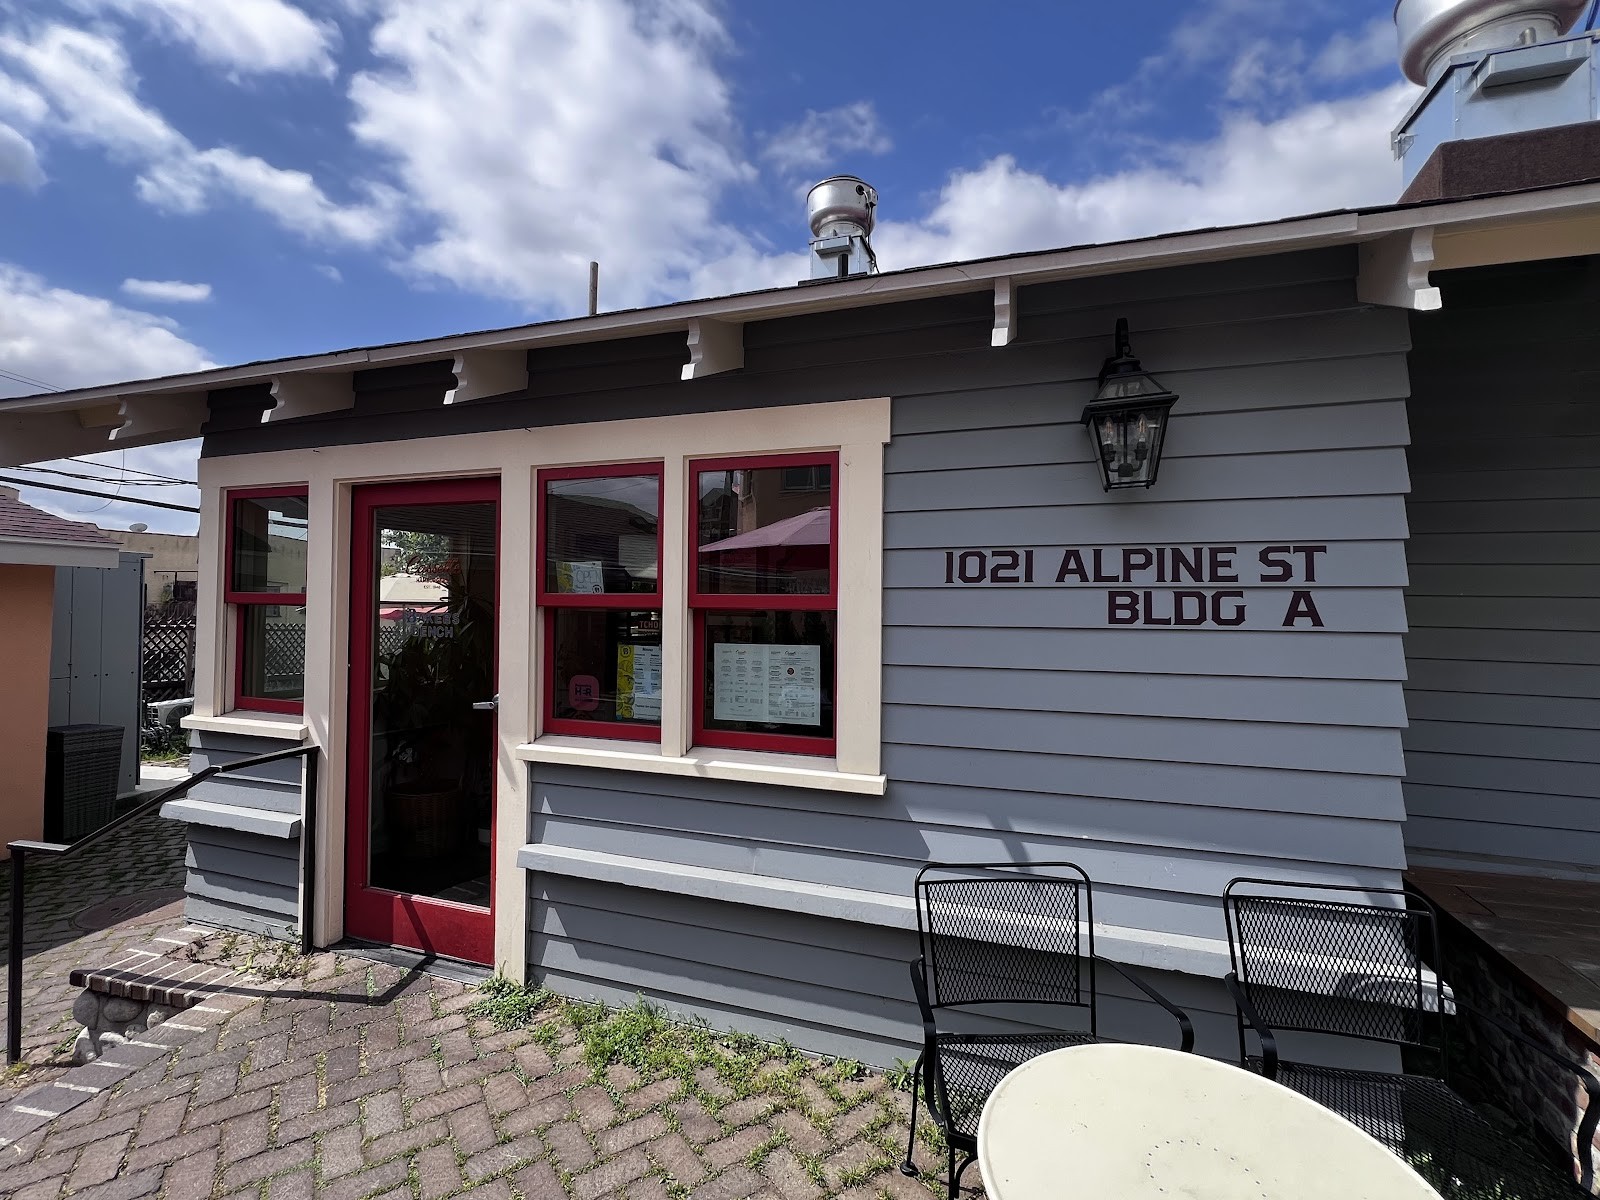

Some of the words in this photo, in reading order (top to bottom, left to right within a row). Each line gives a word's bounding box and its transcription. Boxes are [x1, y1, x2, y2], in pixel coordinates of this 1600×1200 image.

[944, 549, 1034, 583] 1021
[1055, 546, 1239, 583] ALPINE
[1258, 545, 1327, 583] ST
[1107, 590, 1247, 626] BLDG
[1281, 590, 1325, 627] A
[412, 625, 454, 638] BENCH
